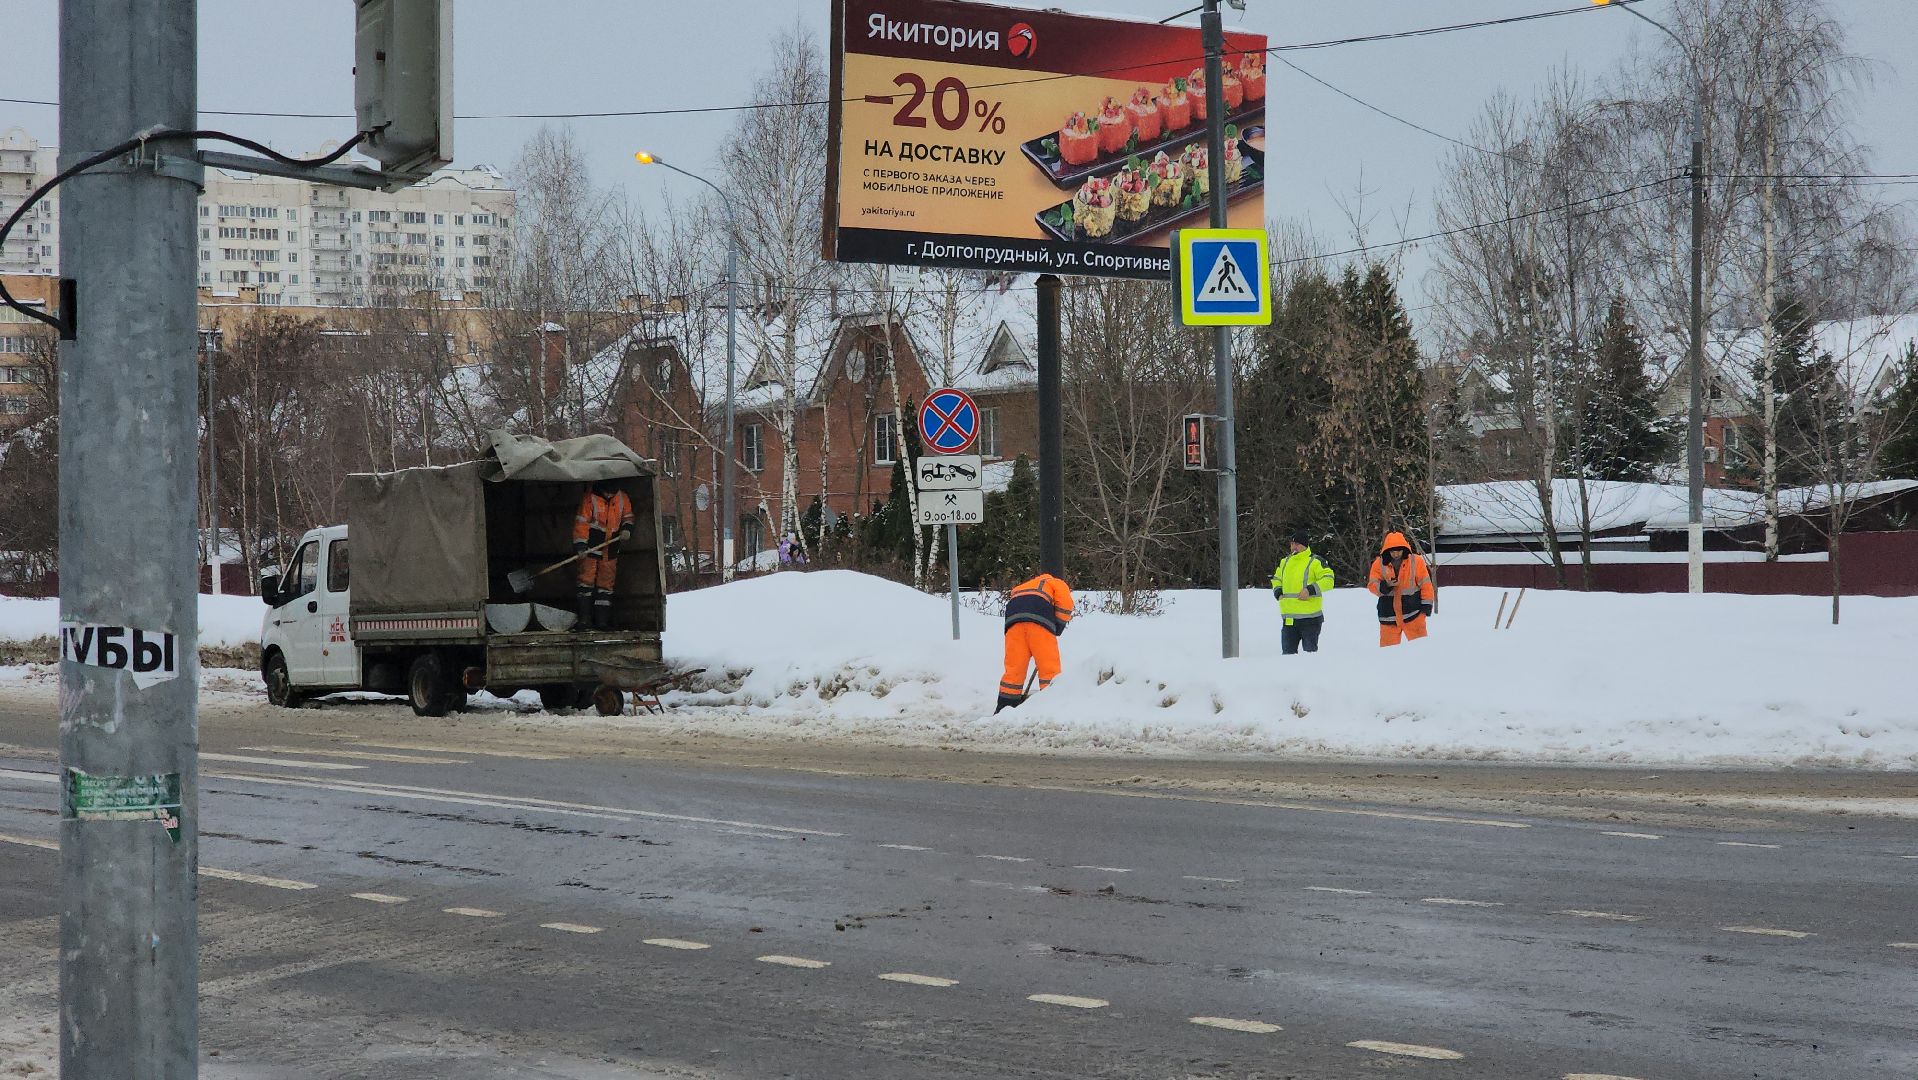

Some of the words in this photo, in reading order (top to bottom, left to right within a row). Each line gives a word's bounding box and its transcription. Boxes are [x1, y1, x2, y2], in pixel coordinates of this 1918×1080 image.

[868, 13, 999, 52] Якитория
[864, 139, 894, 158] НА
[898, 142, 1006, 166] ДОСТАВКУ
[863, 168, 870, 177] С
[873, 169, 920, 181] ПЕРВОГО
[922, 173, 962, 185] ЗАКАЗА
[965, 177, 996, 187] ЧЕРЕЗ
[863, 181, 929, 195] МОБИЛЬНОЕ
[932, 186, 1004, 200] ПРИЛОЖЕНИЕ
[861, 206, 915, 218] yakitoriya.ru
[907, 242, 918, 256] г.
[921, 240, 1053, 266] Долгопрудный,
[1056, 250, 1079, 267] ул.
[924, 509, 977, 522] 9.00-18.00
